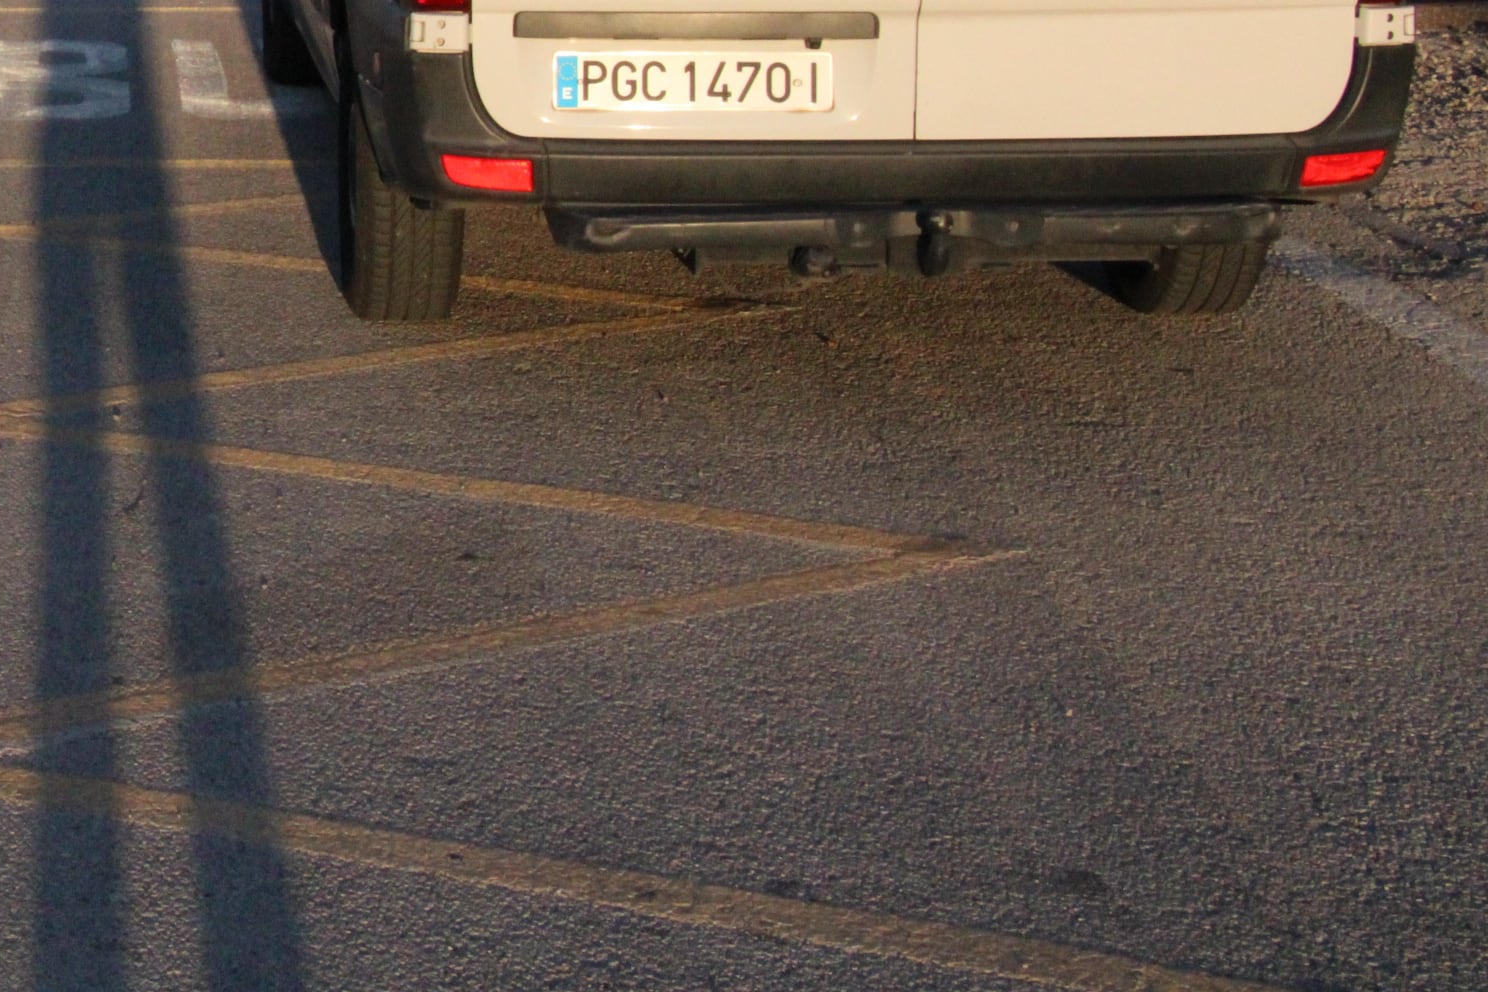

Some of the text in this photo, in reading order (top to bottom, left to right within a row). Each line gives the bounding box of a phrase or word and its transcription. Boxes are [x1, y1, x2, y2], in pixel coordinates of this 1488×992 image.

[562, 87, 573, 100] E
[581, 60, 667, 102] PGC
[684, 61, 792, 104] 1470
